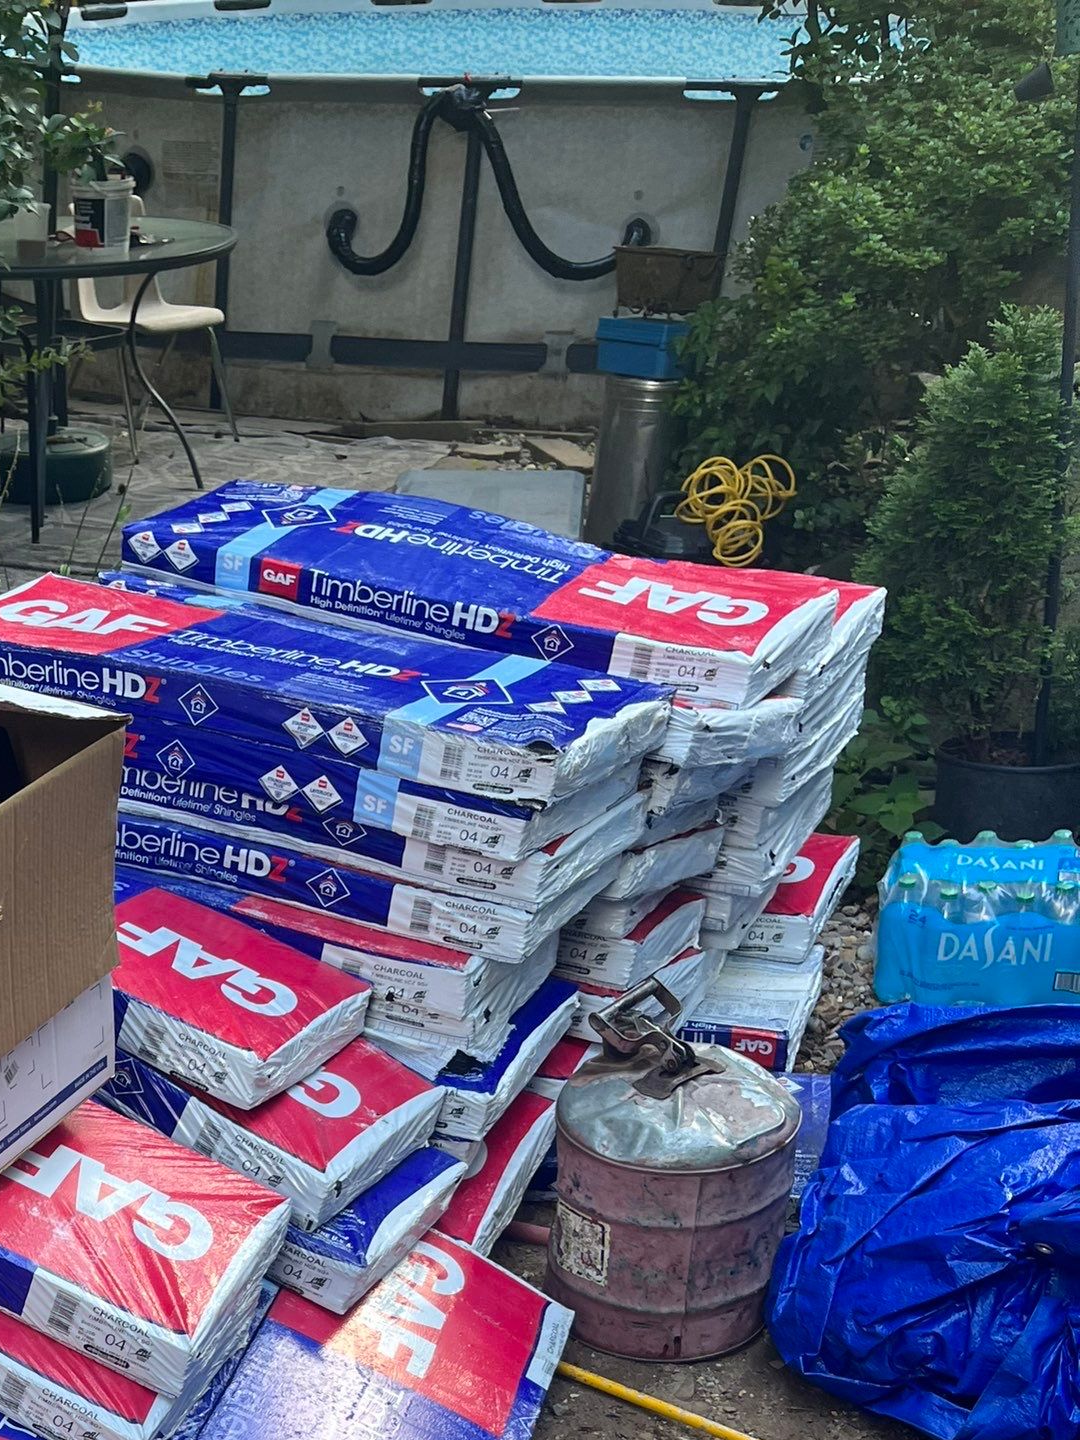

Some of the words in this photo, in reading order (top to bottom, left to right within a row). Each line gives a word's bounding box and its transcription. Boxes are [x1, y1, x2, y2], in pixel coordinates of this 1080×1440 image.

[263, 567, 296, 586] GAF
[310, 568, 449, 623] Timberline
[578, 576, 769, 626] GAF
[310, 595, 333, 609] High
[424, 621, 466, 641] Shingles
[677, 665, 696, 678] 04
[389, 735, 414, 755] SF
[490, 765, 509, 779] 04
[213, 804, 256, 822] Shingles
[364, 794, 388, 814] SF
[447, 807, 499, 825] CHARCOAL
[459, 829, 478, 843] 04
[473, 861, 492, 874] 04
[956, 853, 1045, 871] DASANI
[445, 901, 498, 916] CHARCOAL
[459, 922, 477, 935] 04
[748, 931, 765, 941] 04
[570, 947, 587, 960] 04
[937, 922, 1053, 970] DASANI
[117, 922, 298, 1017] GAF
[373, 963, 425, 980] CHARCOAL
[179, 1032, 227, 1060] CHARCOAL
[735, 1039, 773, 1055] GAF
[187, 1058, 206, 1075] 04
[235, 1134, 286, 1166] CHARCOAL
[241, 1160, 261, 1177] 04
[1, 1144, 213, 1261] GAF
[283, 1264, 302, 1280] 04
[369, 1243, 466, 1379] GAF
[92, 1306, 151, 1339] CHARCOAL
[104, 1334, 126, 1352] 04
[41, 1387, 100, 1421] CHARCOAL
[52, 1414, 74, 1433] 04
